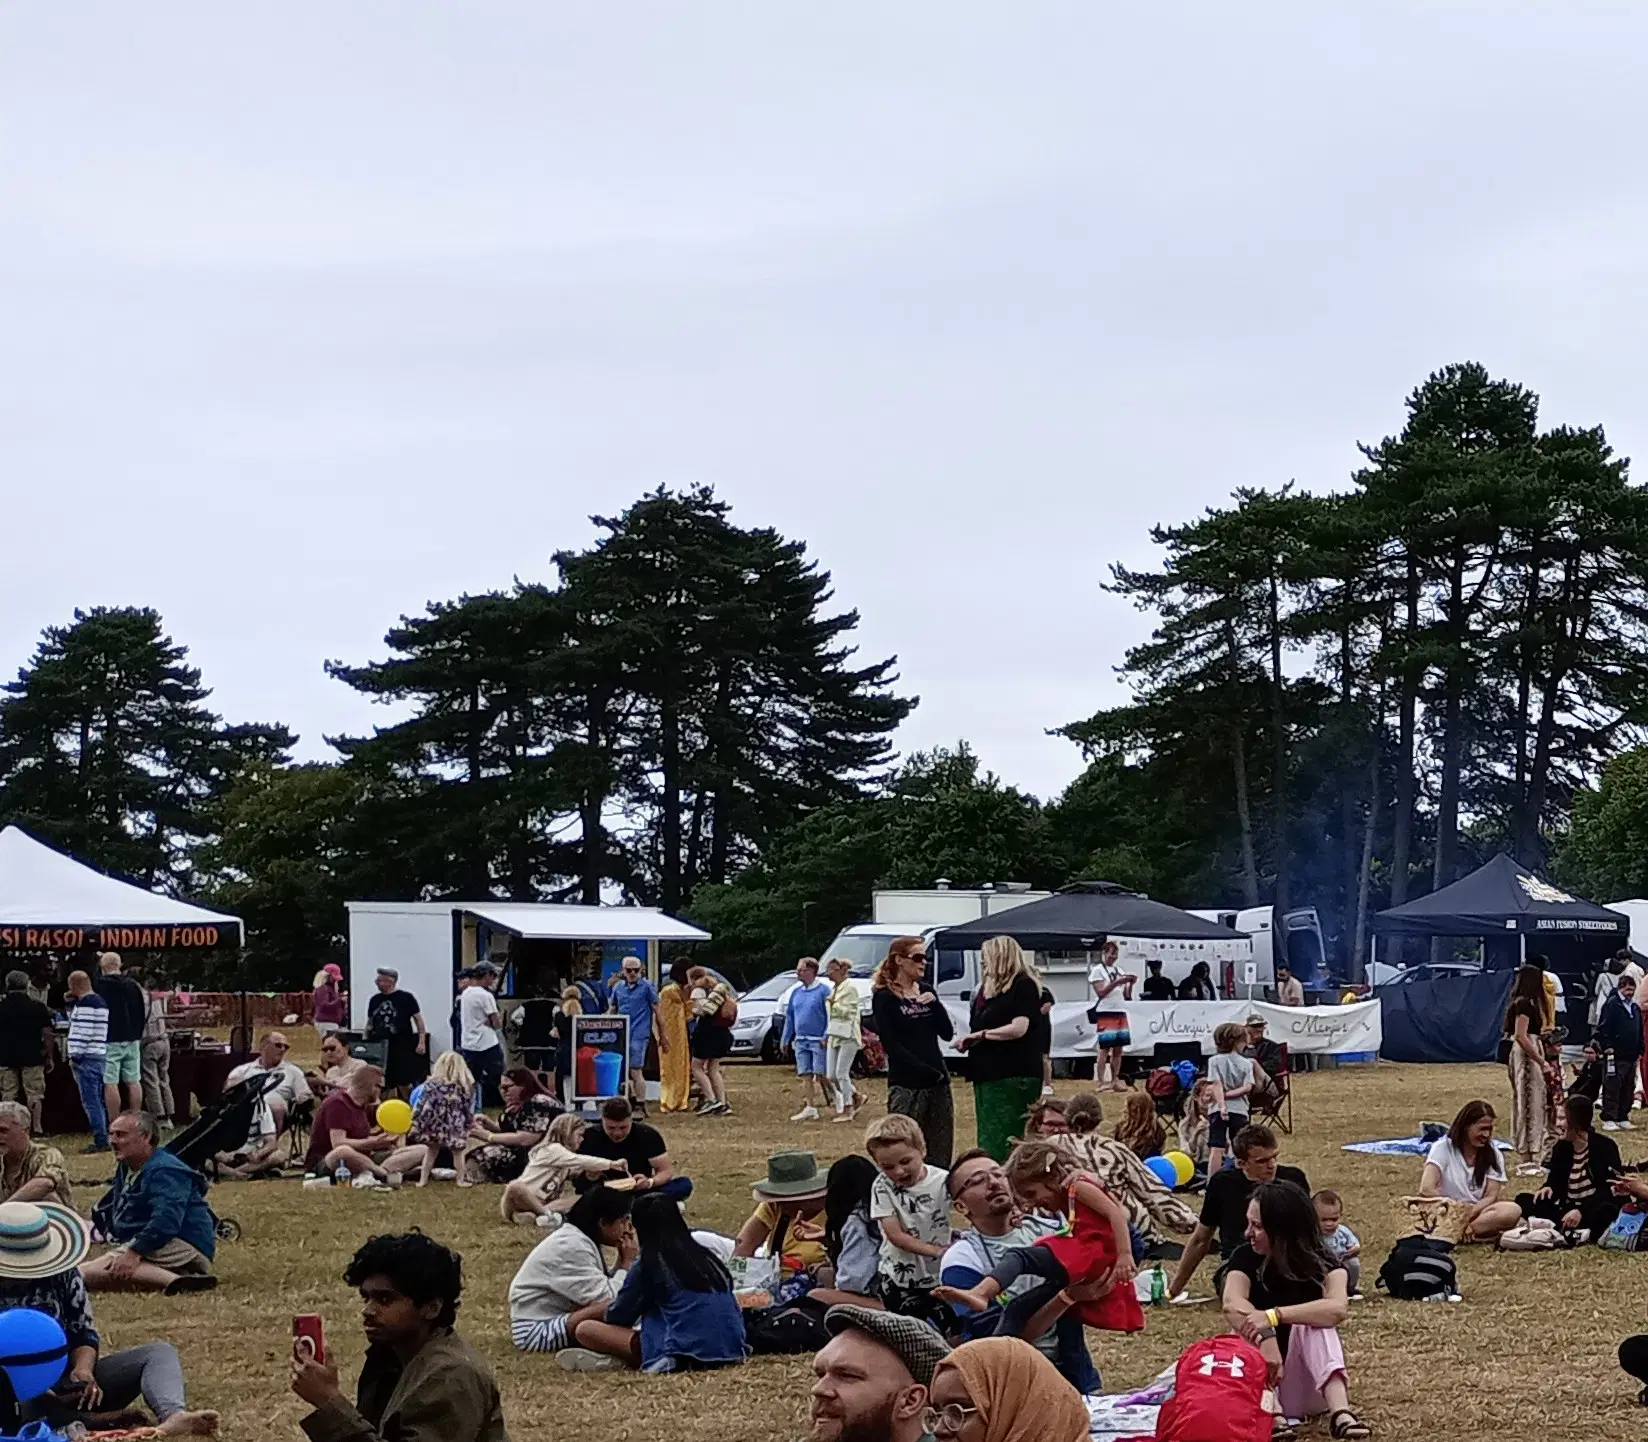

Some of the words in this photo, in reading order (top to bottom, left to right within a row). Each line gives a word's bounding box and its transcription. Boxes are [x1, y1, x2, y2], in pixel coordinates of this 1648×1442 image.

[0, 927, 20, 948] SI
[26, 928, 83, 948] RASOI
[100, 927, 166, 948] INDIAN
[171, 926, 219, 947] FOOD
